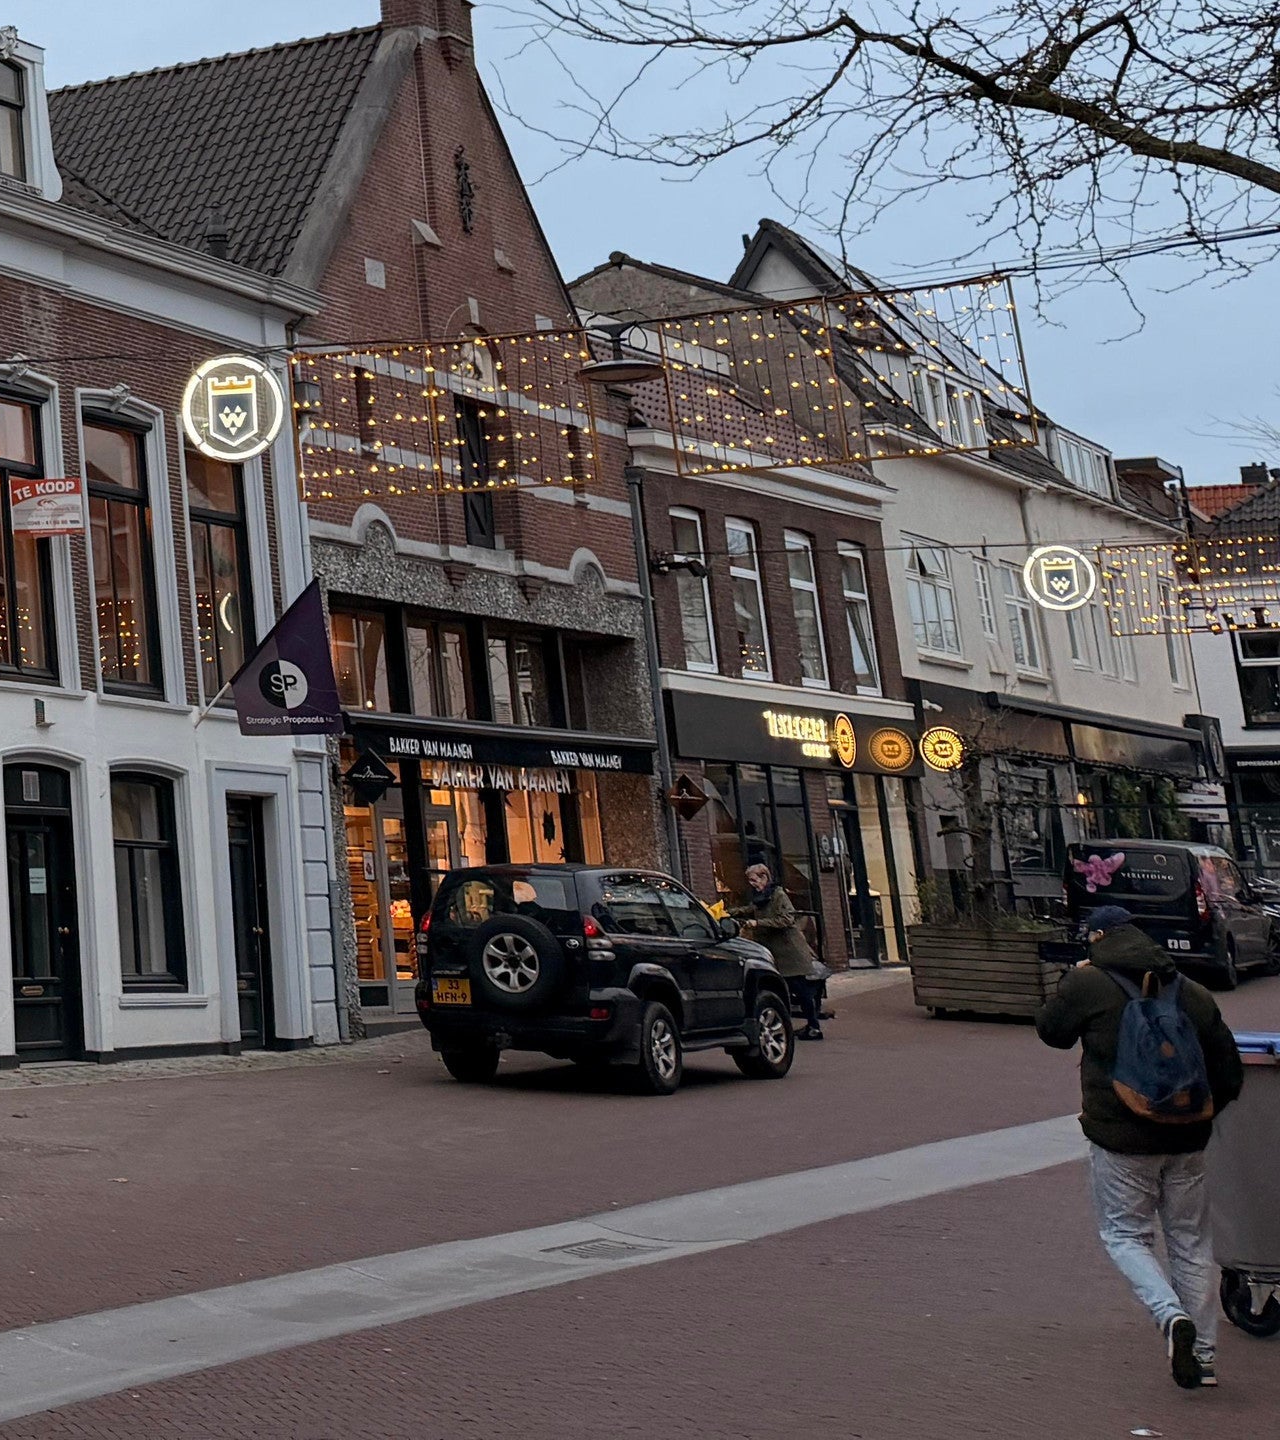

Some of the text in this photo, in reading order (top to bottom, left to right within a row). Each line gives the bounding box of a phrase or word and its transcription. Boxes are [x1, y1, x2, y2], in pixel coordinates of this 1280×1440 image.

[13, 481, 75, 500] TE KOOP
[270, 674, 298, 692] SP
[246, 715, 282, 725] Strategic
[283, 715, 325, 725] Proposals
[389, 736, 473, 759] BAKKER VAN MAANEN
[550, 750, 622, 769] BAKKER VAN MAANEN
[487, 764, 515, 790] VAN
[448, 979, 460, 990] 33
